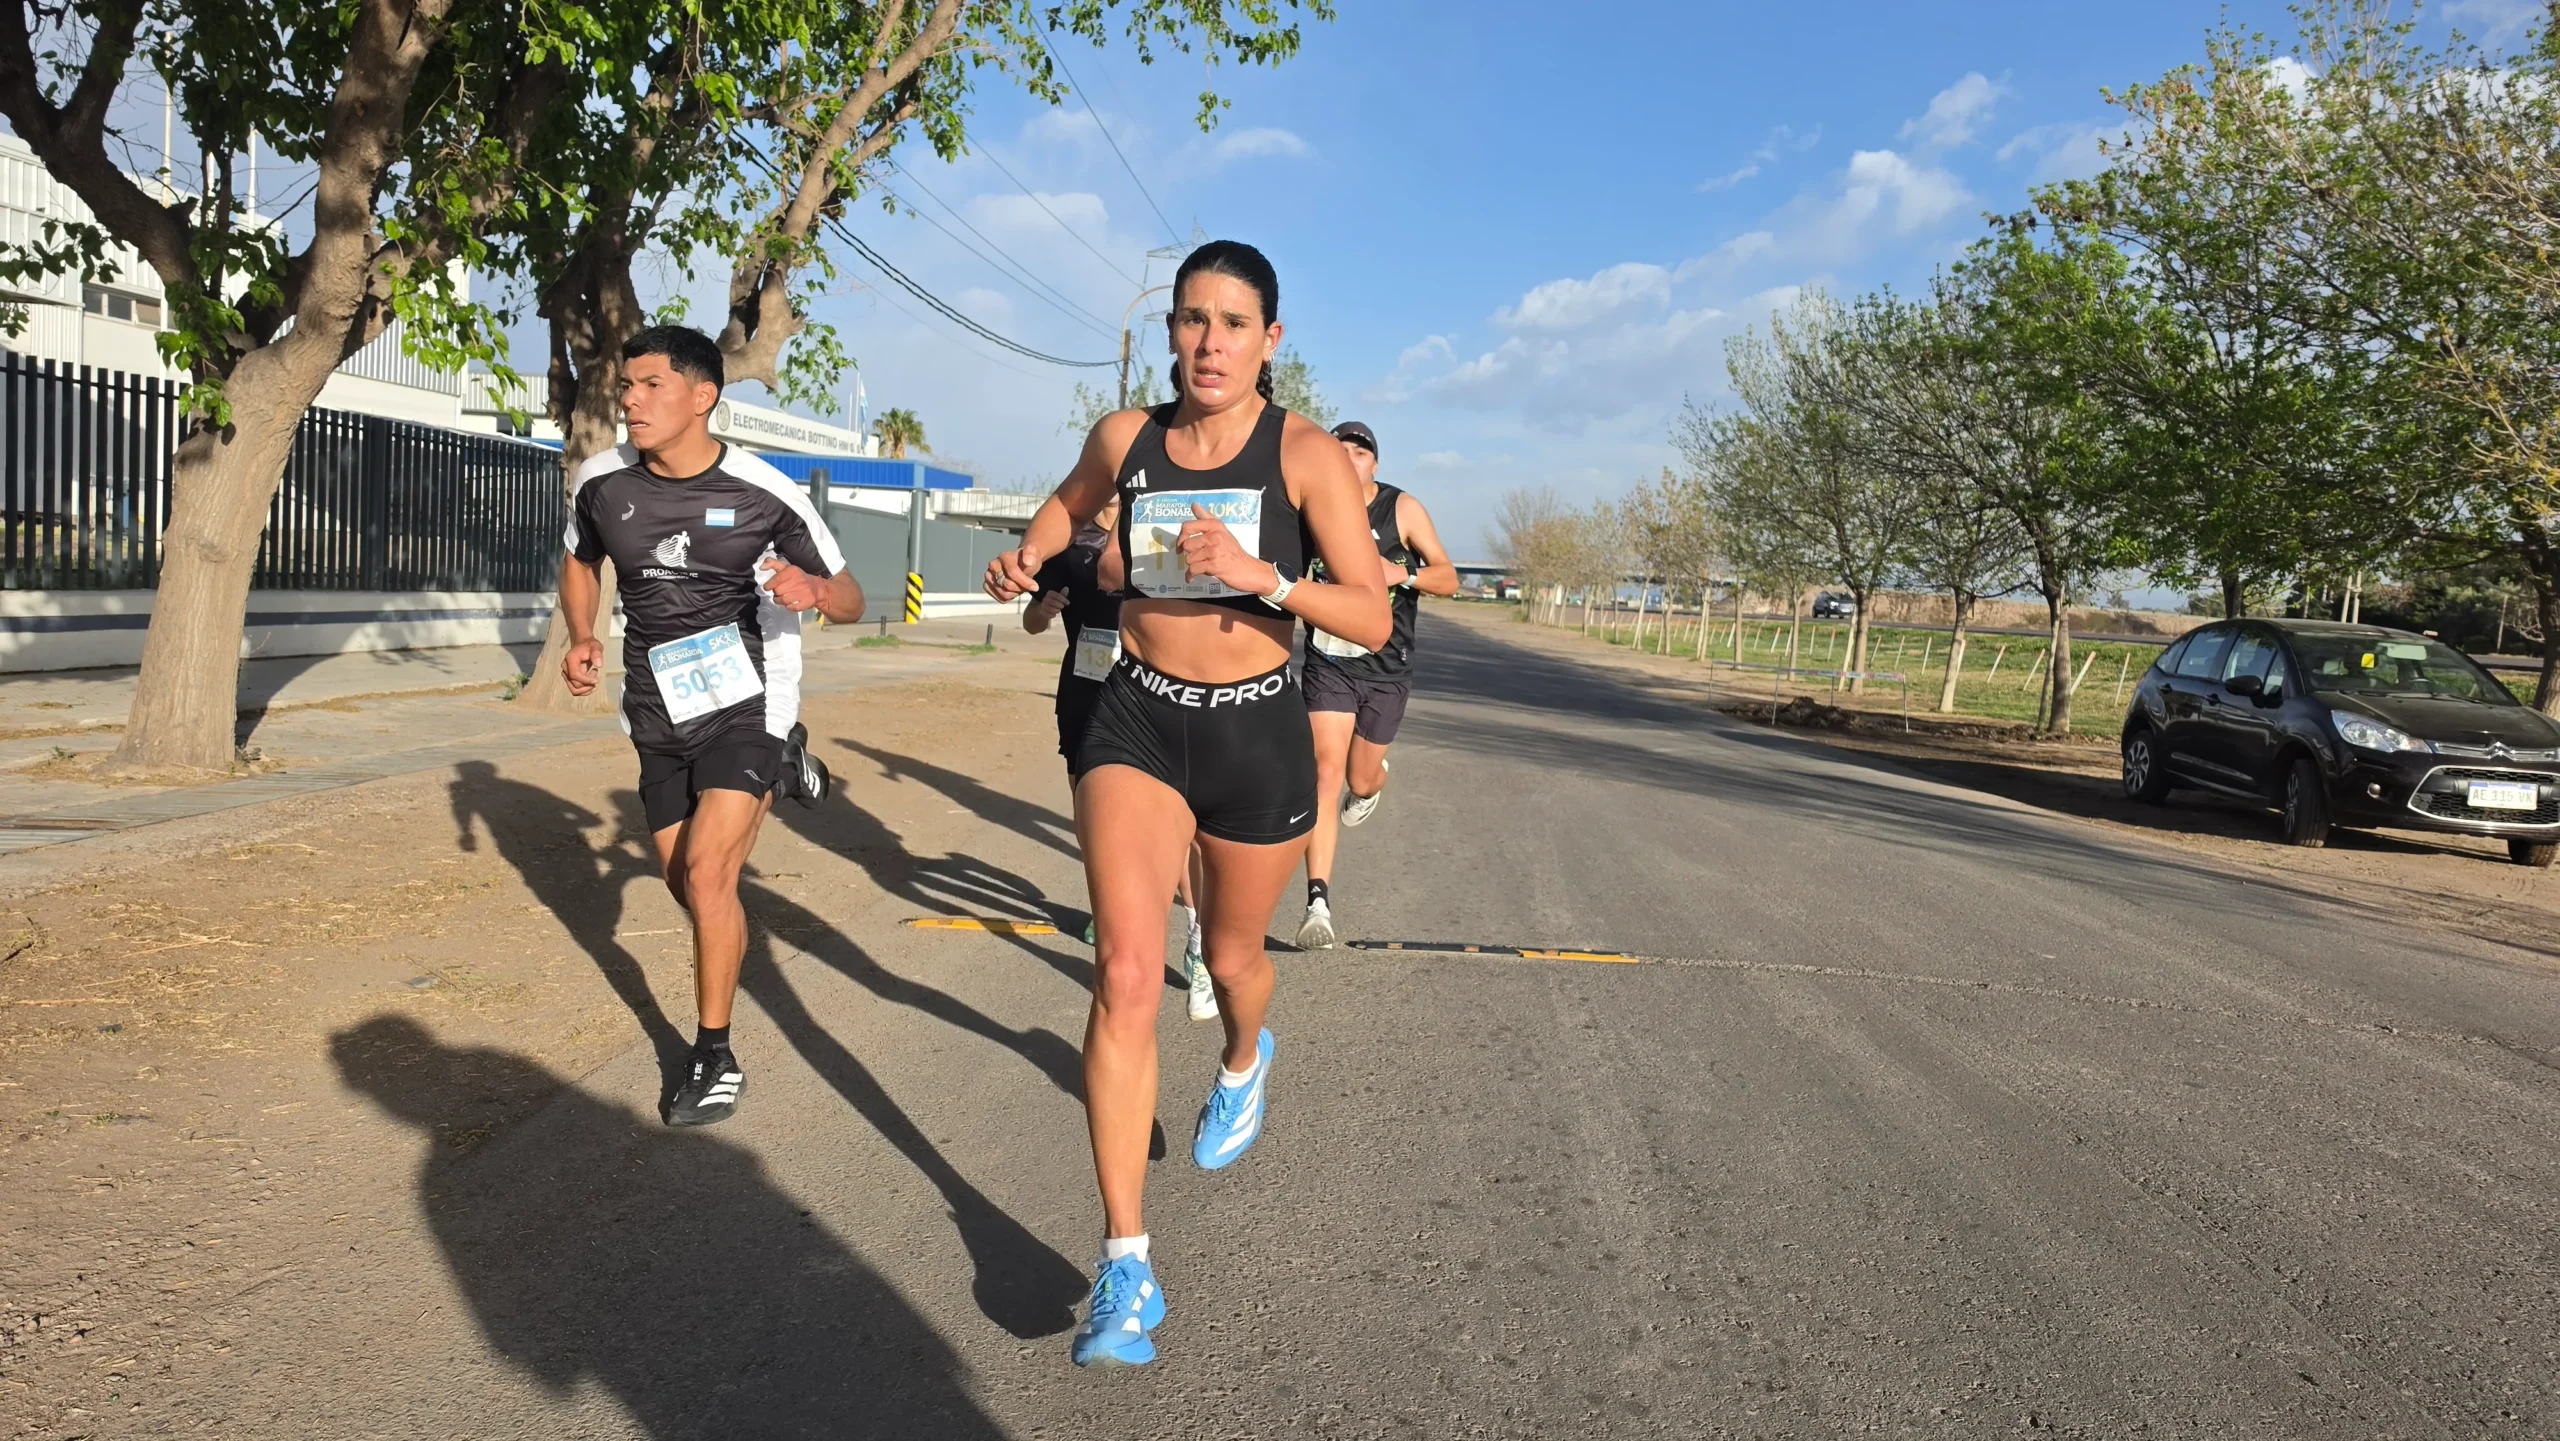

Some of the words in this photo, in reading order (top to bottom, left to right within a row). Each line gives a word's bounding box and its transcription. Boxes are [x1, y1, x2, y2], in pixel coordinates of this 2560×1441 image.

[733, 412, 806, 442] ELECTROMECANICA
[808, 430, 837, 449] BOTTINO
[1155, 508, 1194, 517] BONAR
[1209, 502, 1238, 518] 10K
[709, 635, 726, 651] 5K
[667, 648, 703, 663] BONARDA
[671, 656, 742, 700] 5053
[1130, 664, 1207, 708] NIKE
[1209, 674, 1284, 708] PRO
[2472, 789, 2488, 801] AE
